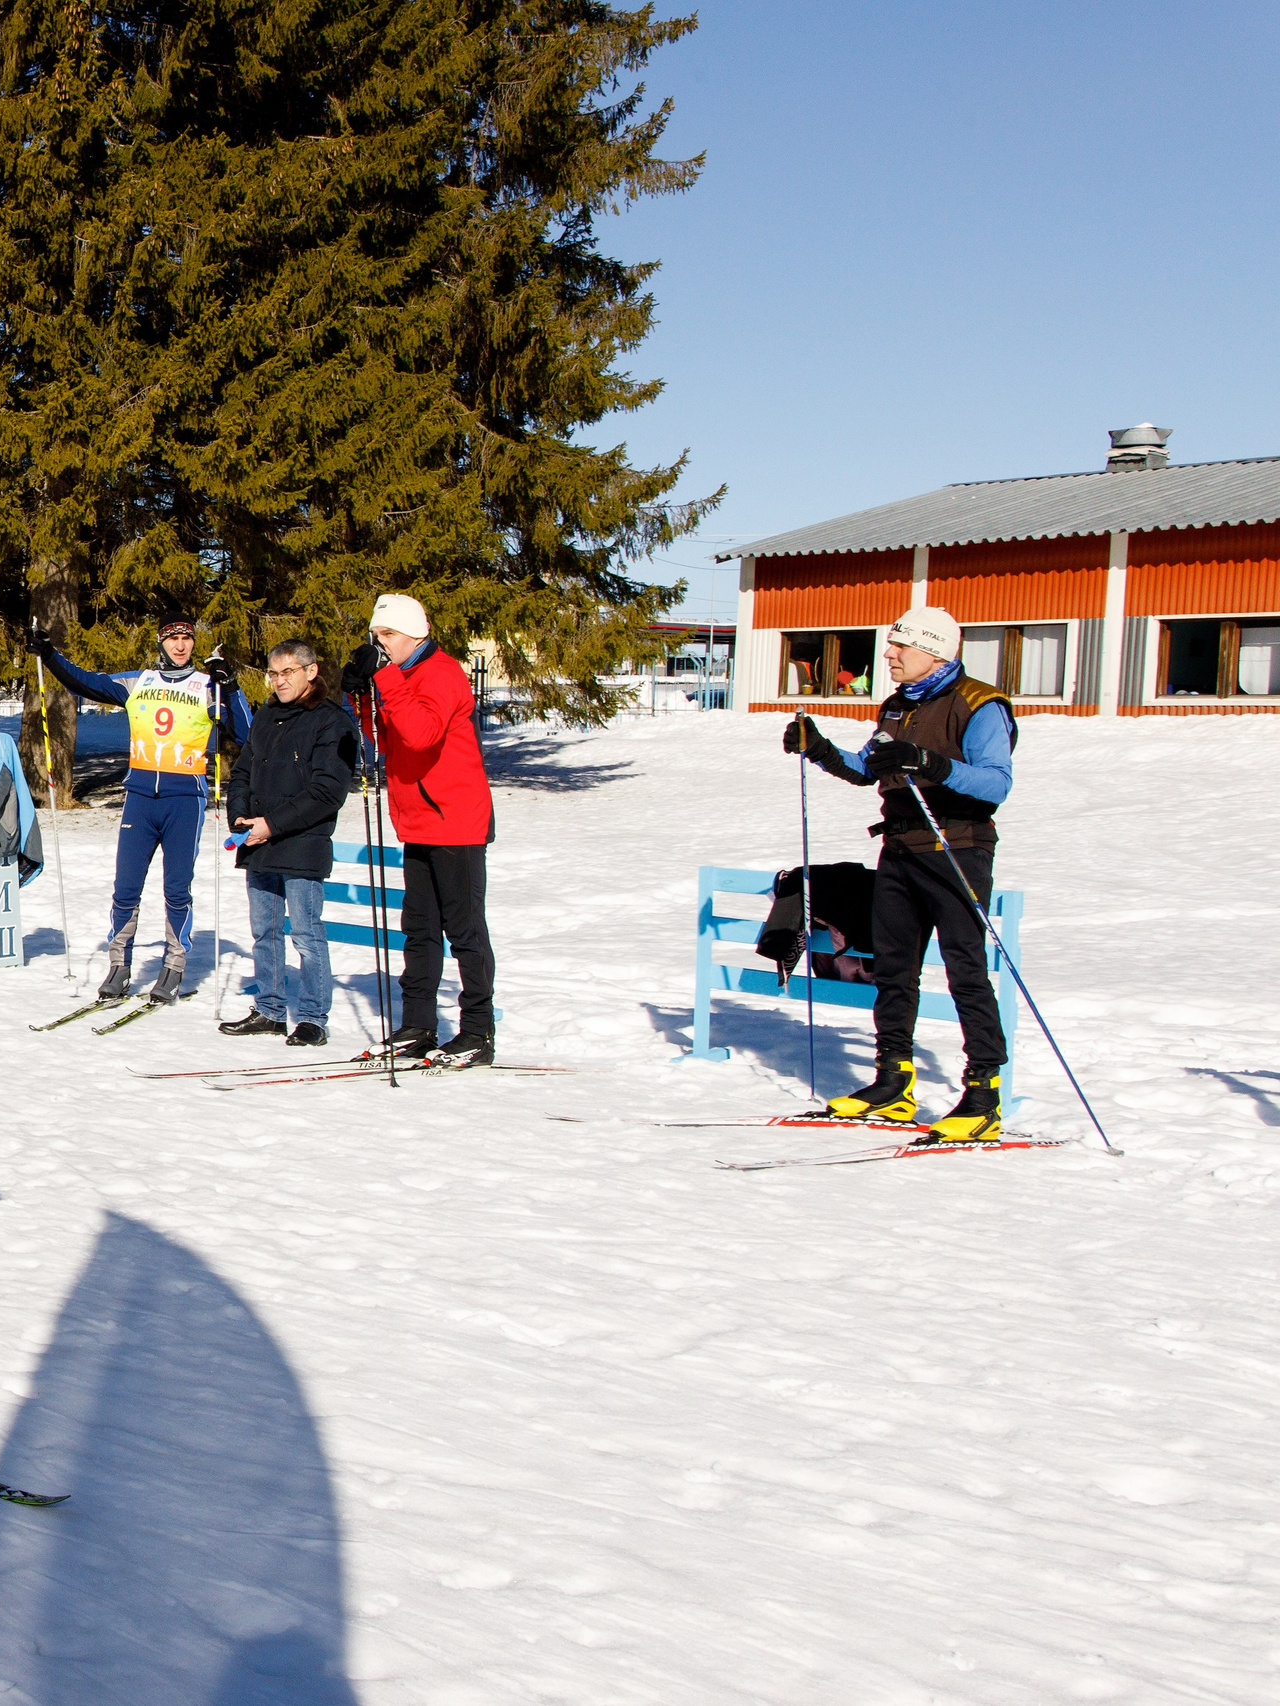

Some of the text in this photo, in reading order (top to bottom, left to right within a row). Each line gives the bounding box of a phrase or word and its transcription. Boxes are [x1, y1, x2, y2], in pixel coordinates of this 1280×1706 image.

[136, 688, 200, 708] AKKERMANN
[154, 707, 174, 736] 9
[184, 755, 193, 767] 4
[785, 1116, 918, 1129] MADSHUS
[907, 1140, 1002, 1152] MADSHUS
